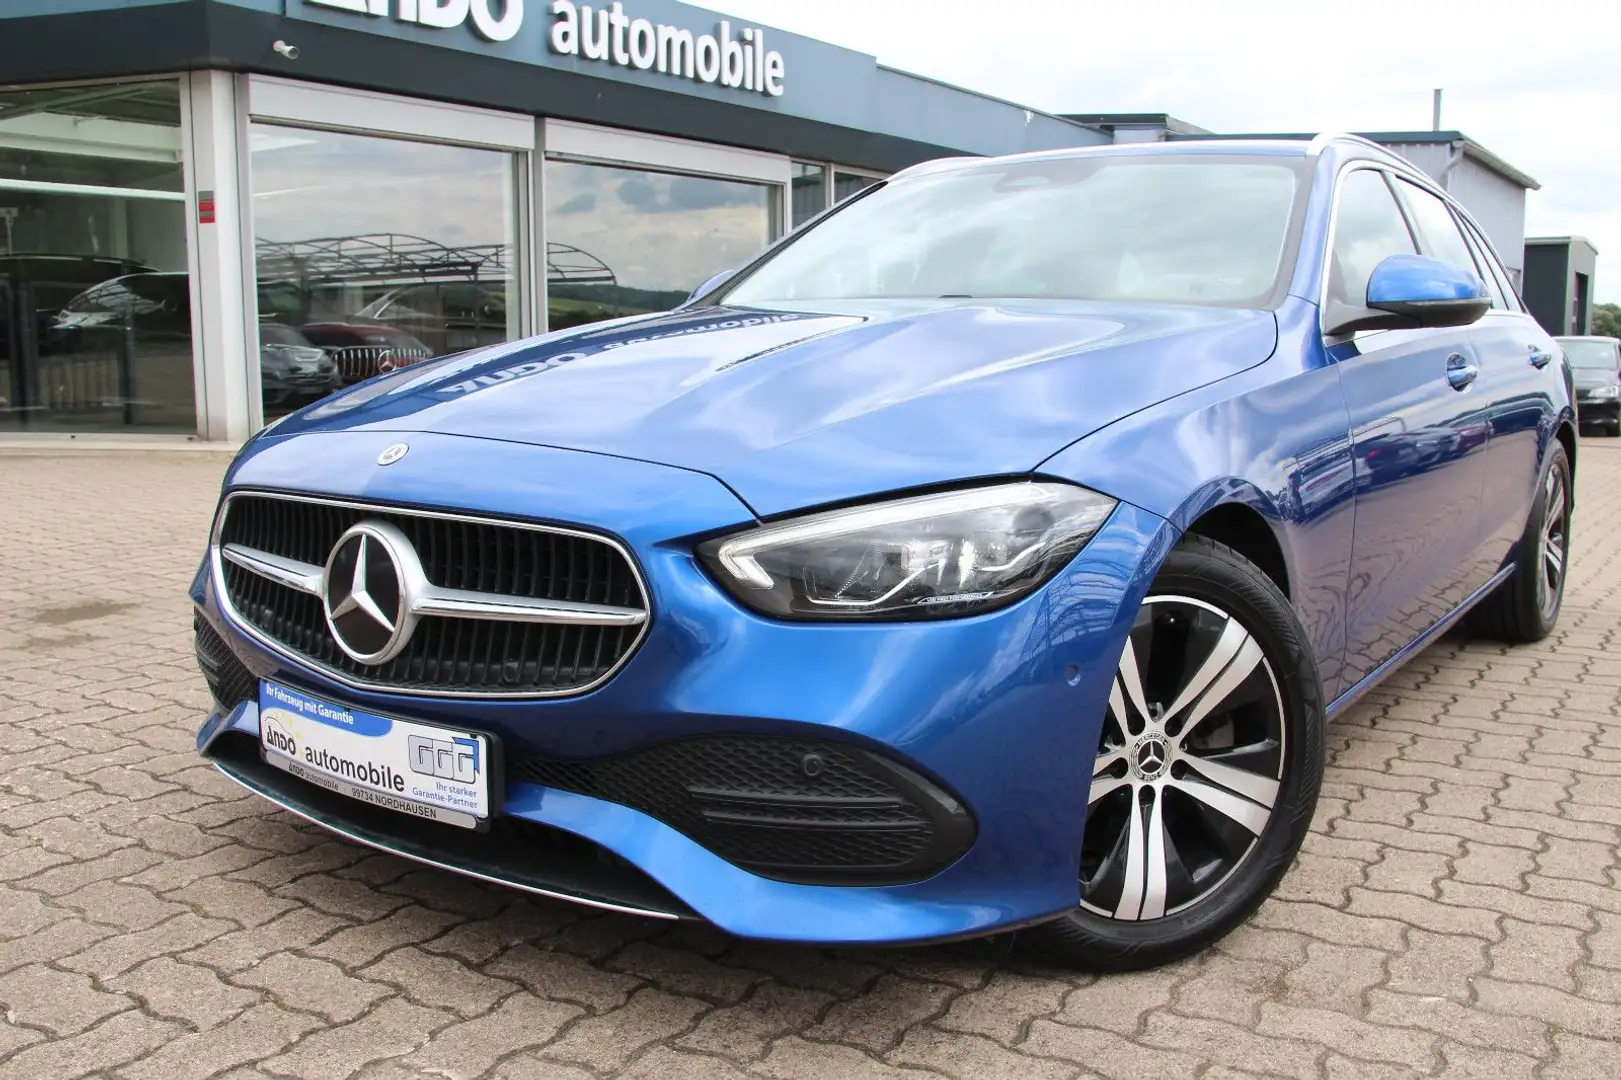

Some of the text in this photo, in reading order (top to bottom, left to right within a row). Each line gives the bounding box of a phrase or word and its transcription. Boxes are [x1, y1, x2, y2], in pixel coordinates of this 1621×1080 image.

[550, 0, 785, 96] automobile
[266, 683, 354, 725] Ihr Fahrzeug mit Garantie
[305, 746, 405, 792] automobile
[436, 781, 477, 798] Ihr starker
[305, 771, 339, 791] automobile
[351, 787, 374, 802] 99734
[375, 795, 437, 819] NORDHAUSEN
[412, 786, 478, 809] Garantie-Partner
